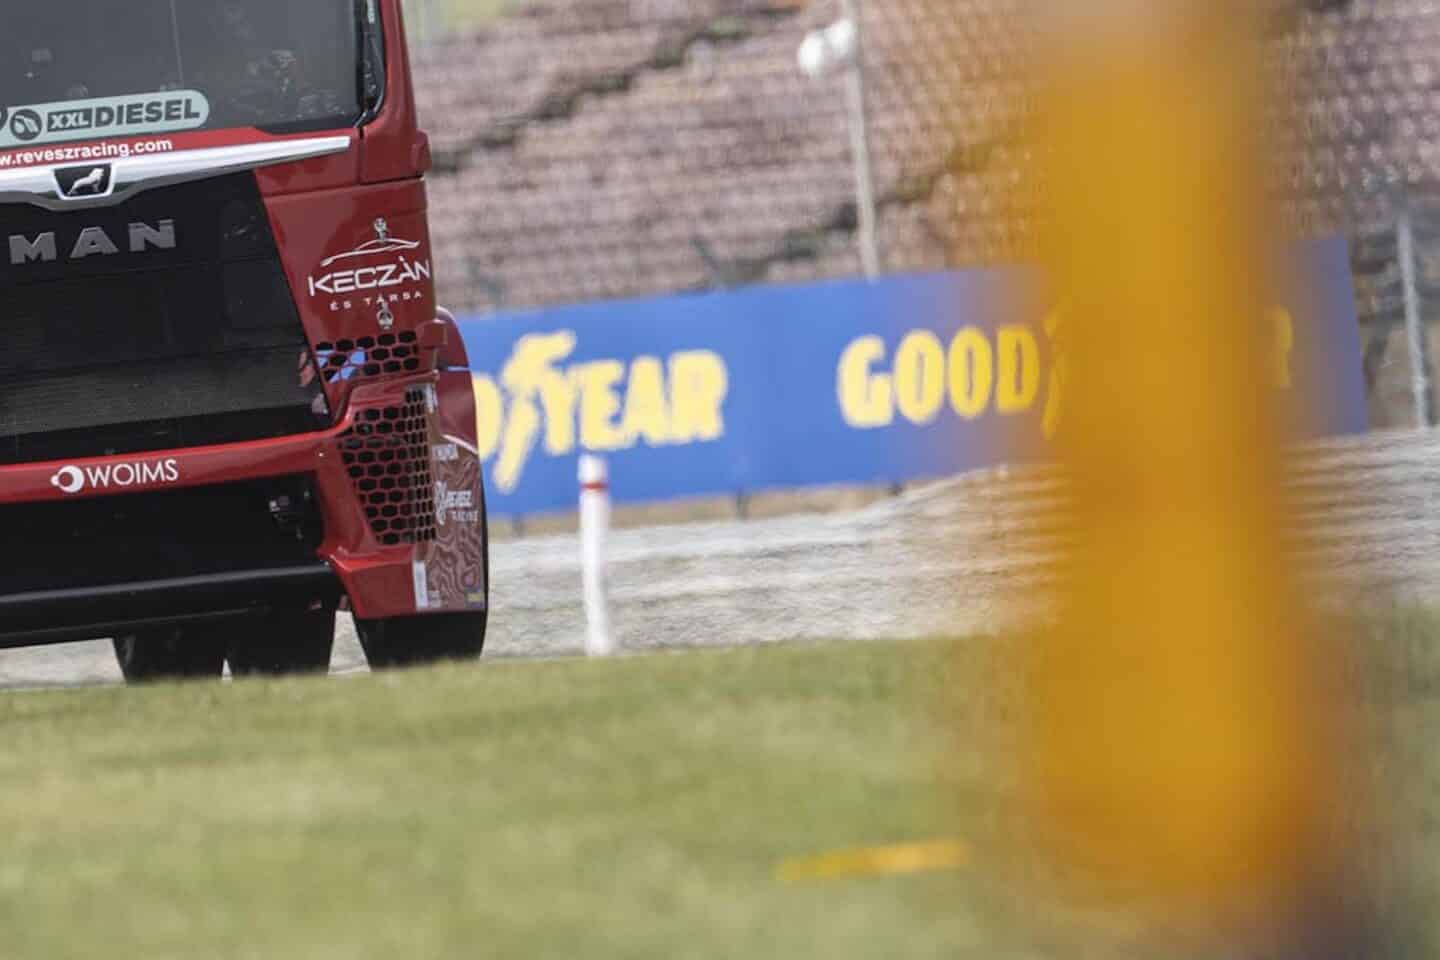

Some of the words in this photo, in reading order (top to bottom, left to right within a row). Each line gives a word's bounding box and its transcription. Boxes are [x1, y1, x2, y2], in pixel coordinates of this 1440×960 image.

[95, 99, 200, 127] DIESEL
[8, 219, 176, 264] MAN
[85, 459, 178, 488] WOIMS
